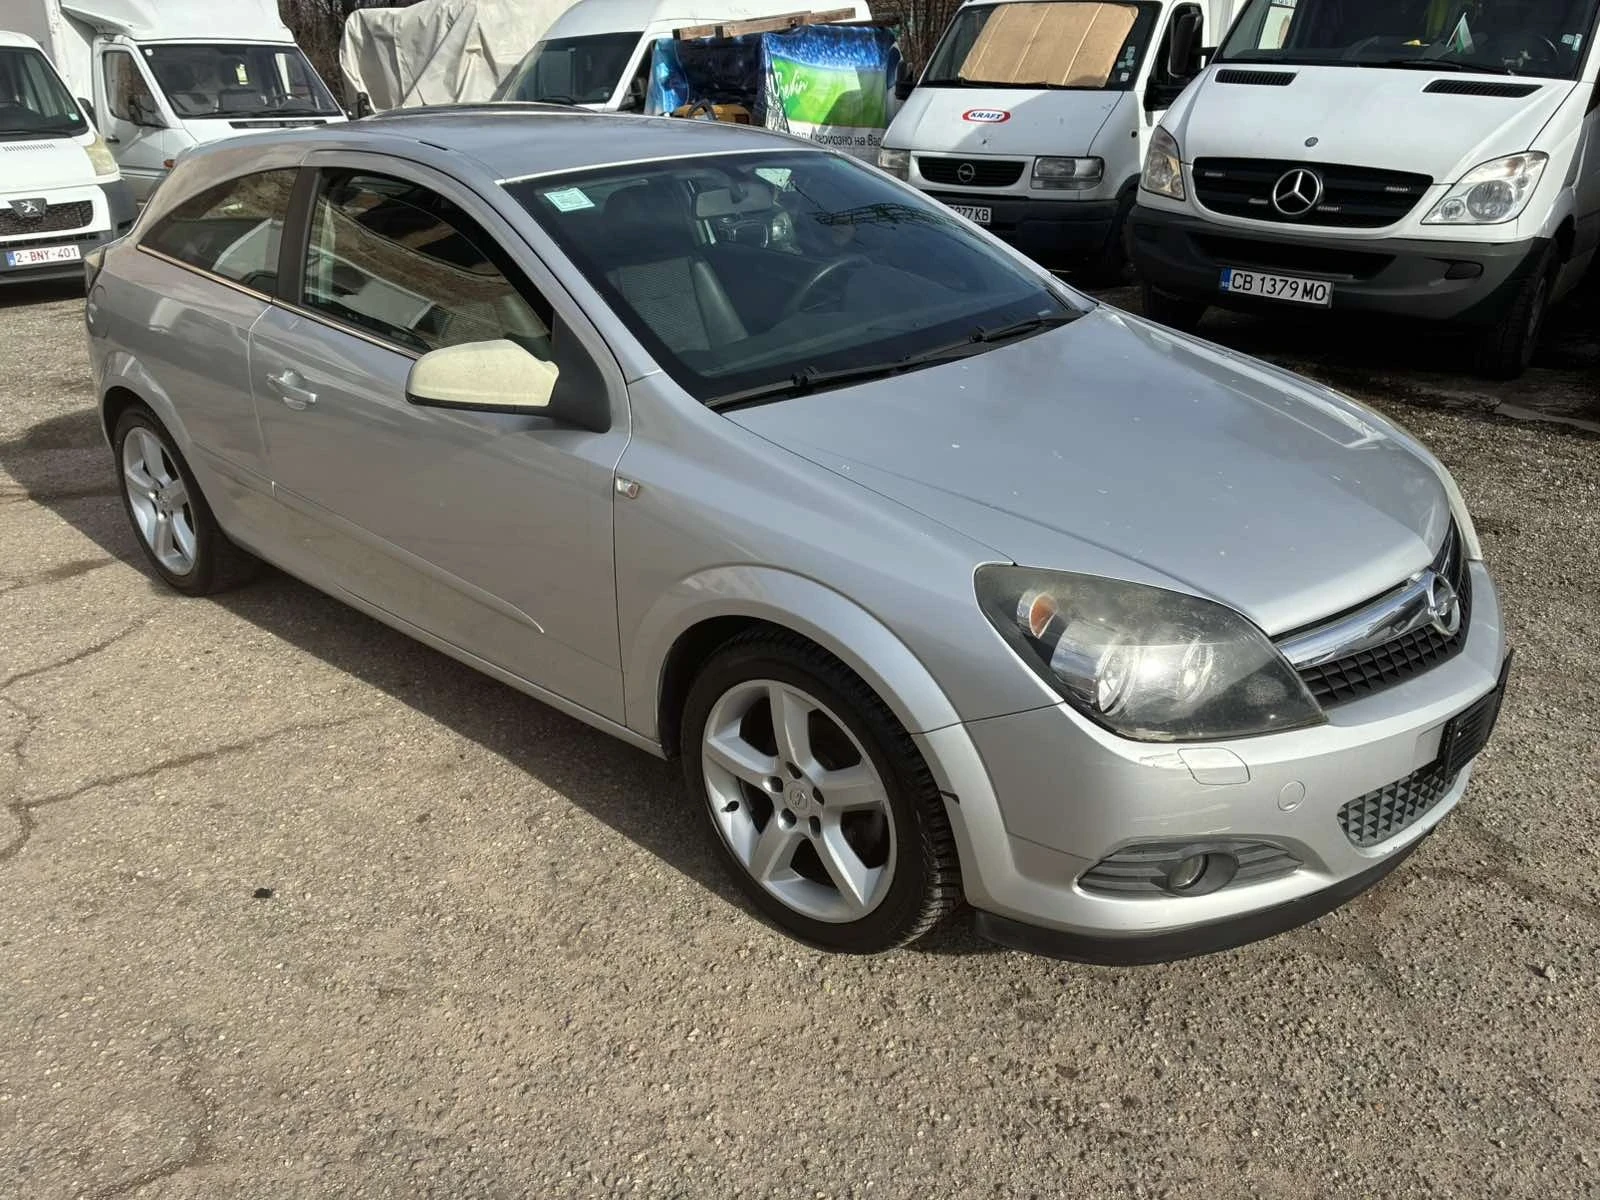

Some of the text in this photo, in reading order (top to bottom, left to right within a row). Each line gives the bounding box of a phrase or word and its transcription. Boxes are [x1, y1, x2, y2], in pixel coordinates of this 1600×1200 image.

[970, 112, 1003, 120] KRAFT
[1231, 272, 1327, 302] CB 1379 MO
